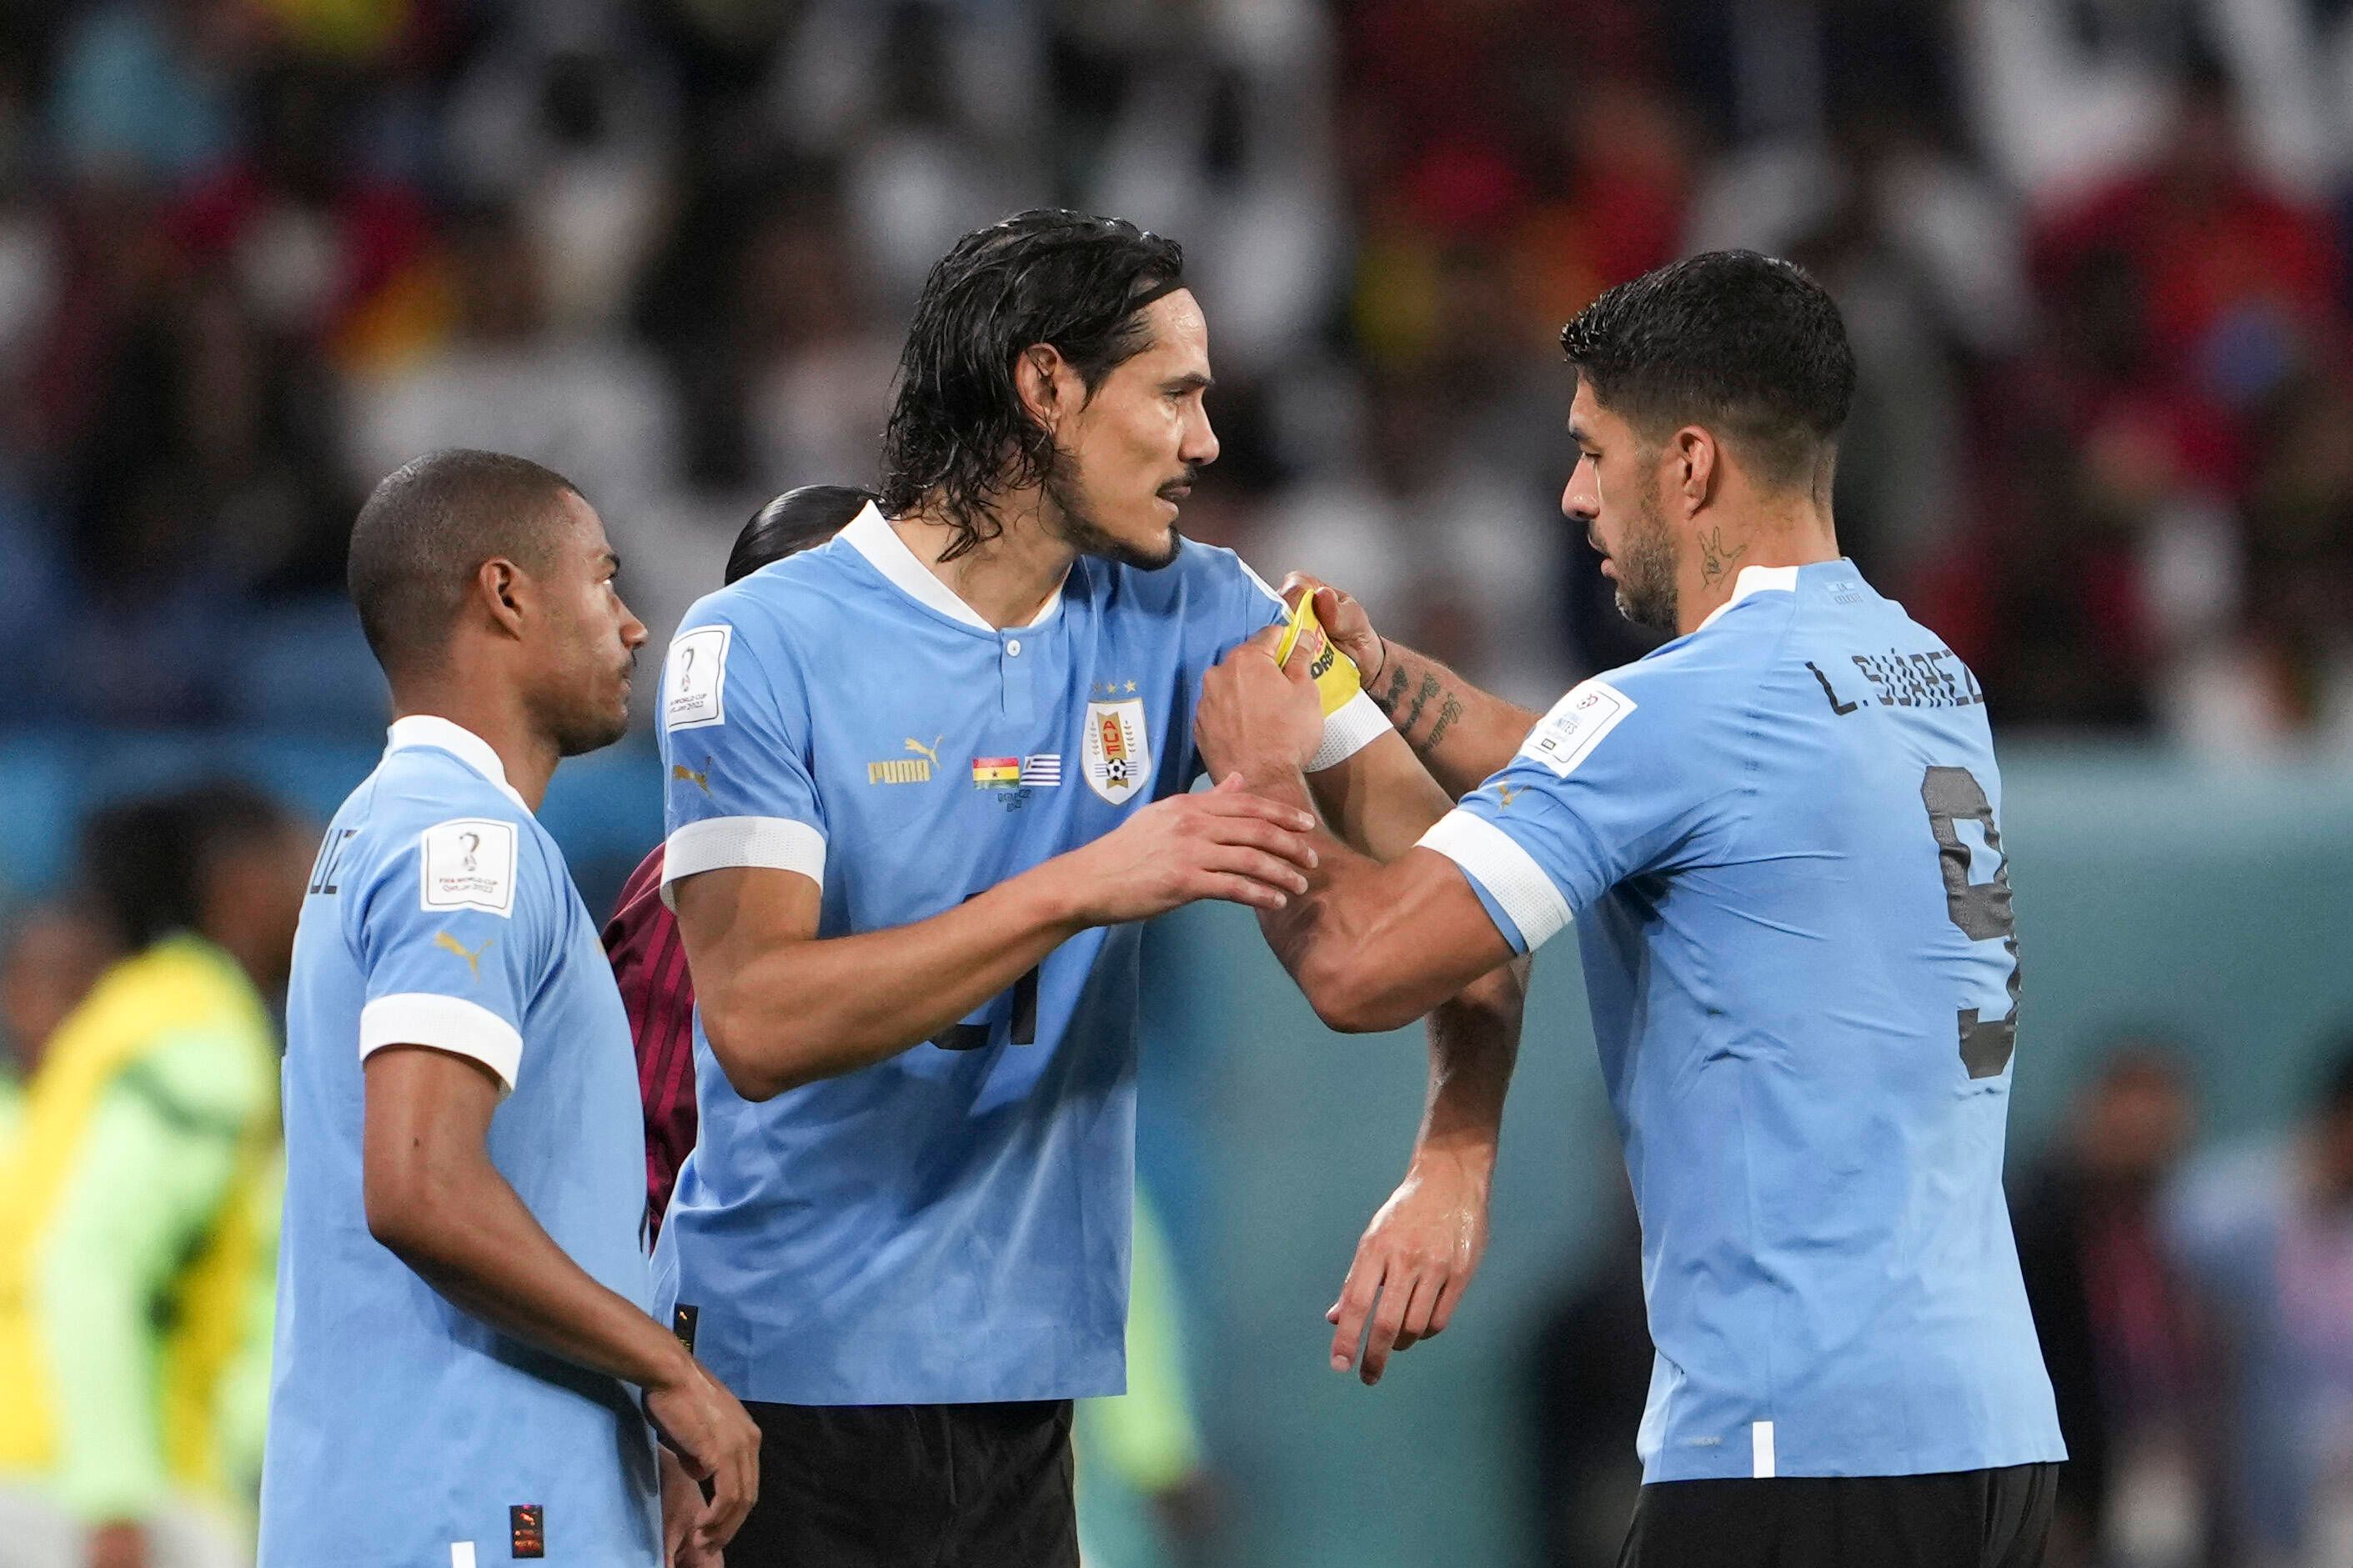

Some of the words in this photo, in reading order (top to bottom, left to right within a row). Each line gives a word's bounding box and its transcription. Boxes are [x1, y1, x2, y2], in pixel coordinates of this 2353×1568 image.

[1804, 660, 1868, 717] L.
[1102, 720, 1122, 755] AUF
[868, 759, 931, 785] PUMA
[1920, 765, 2022, 1080] 9
